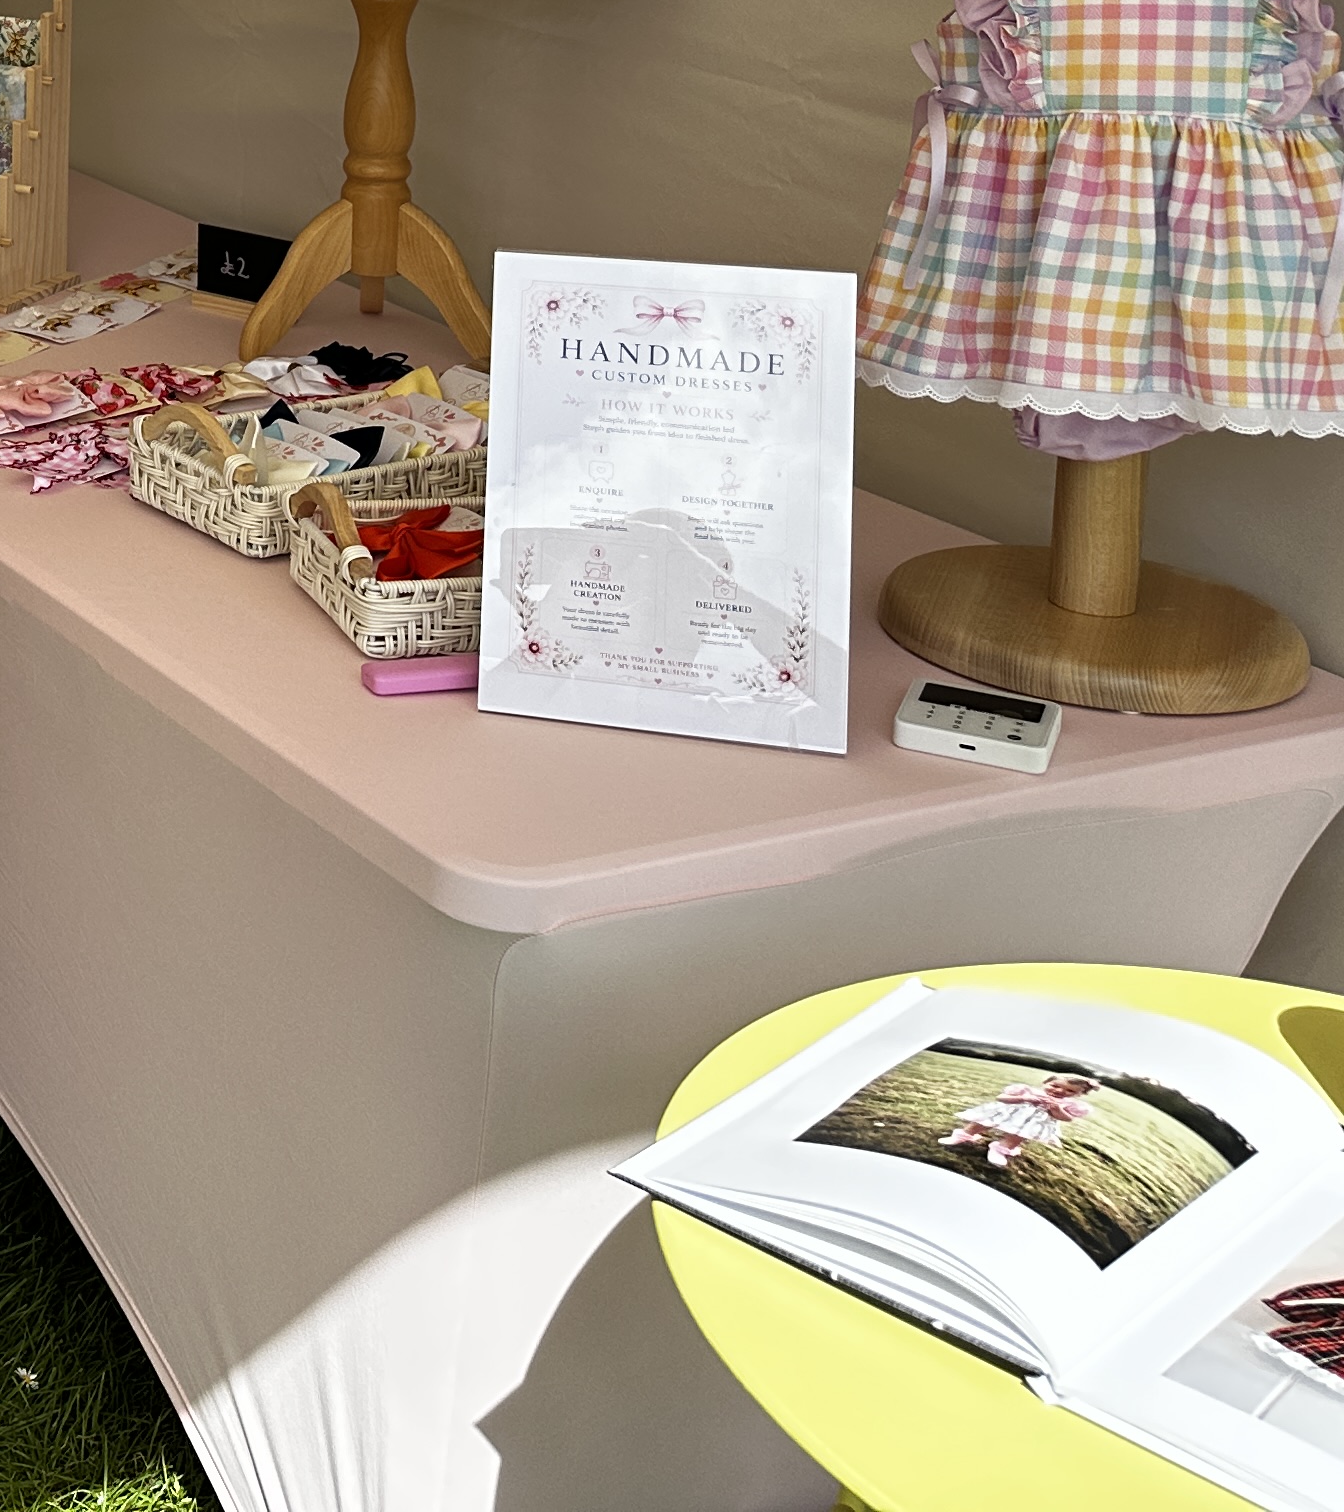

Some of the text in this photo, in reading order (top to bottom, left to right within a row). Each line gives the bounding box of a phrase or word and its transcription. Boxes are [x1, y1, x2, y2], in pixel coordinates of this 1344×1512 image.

[220, 250, 250, 279] £2
[560, 337, 785, 377] HANDMADE
[591, 369, 753, 393] CUSTOM DRESSES
[601, 398, 734, 421] HOW IT WORKS
[725, 456, 732, 465] 2
[579, 485, 624, 496] ENQUIRE
[682, 495, 775, 511] DESIGN TOGETHER
[593, 548, 601, 558] 3
[722, 561, 729, 570] 4
[570, 579, 626, 592] HANDMADE
[573, 590, 622, 601] CREATION
[695, 600, 752, 614] DELIVERED
[600, 652, 628, 662] THANK
[630, 655, 646, 664] YOU
[649, 657, 665, 666] FOR
[618, 662, 700, 678] MY SMALL BUSINESS
